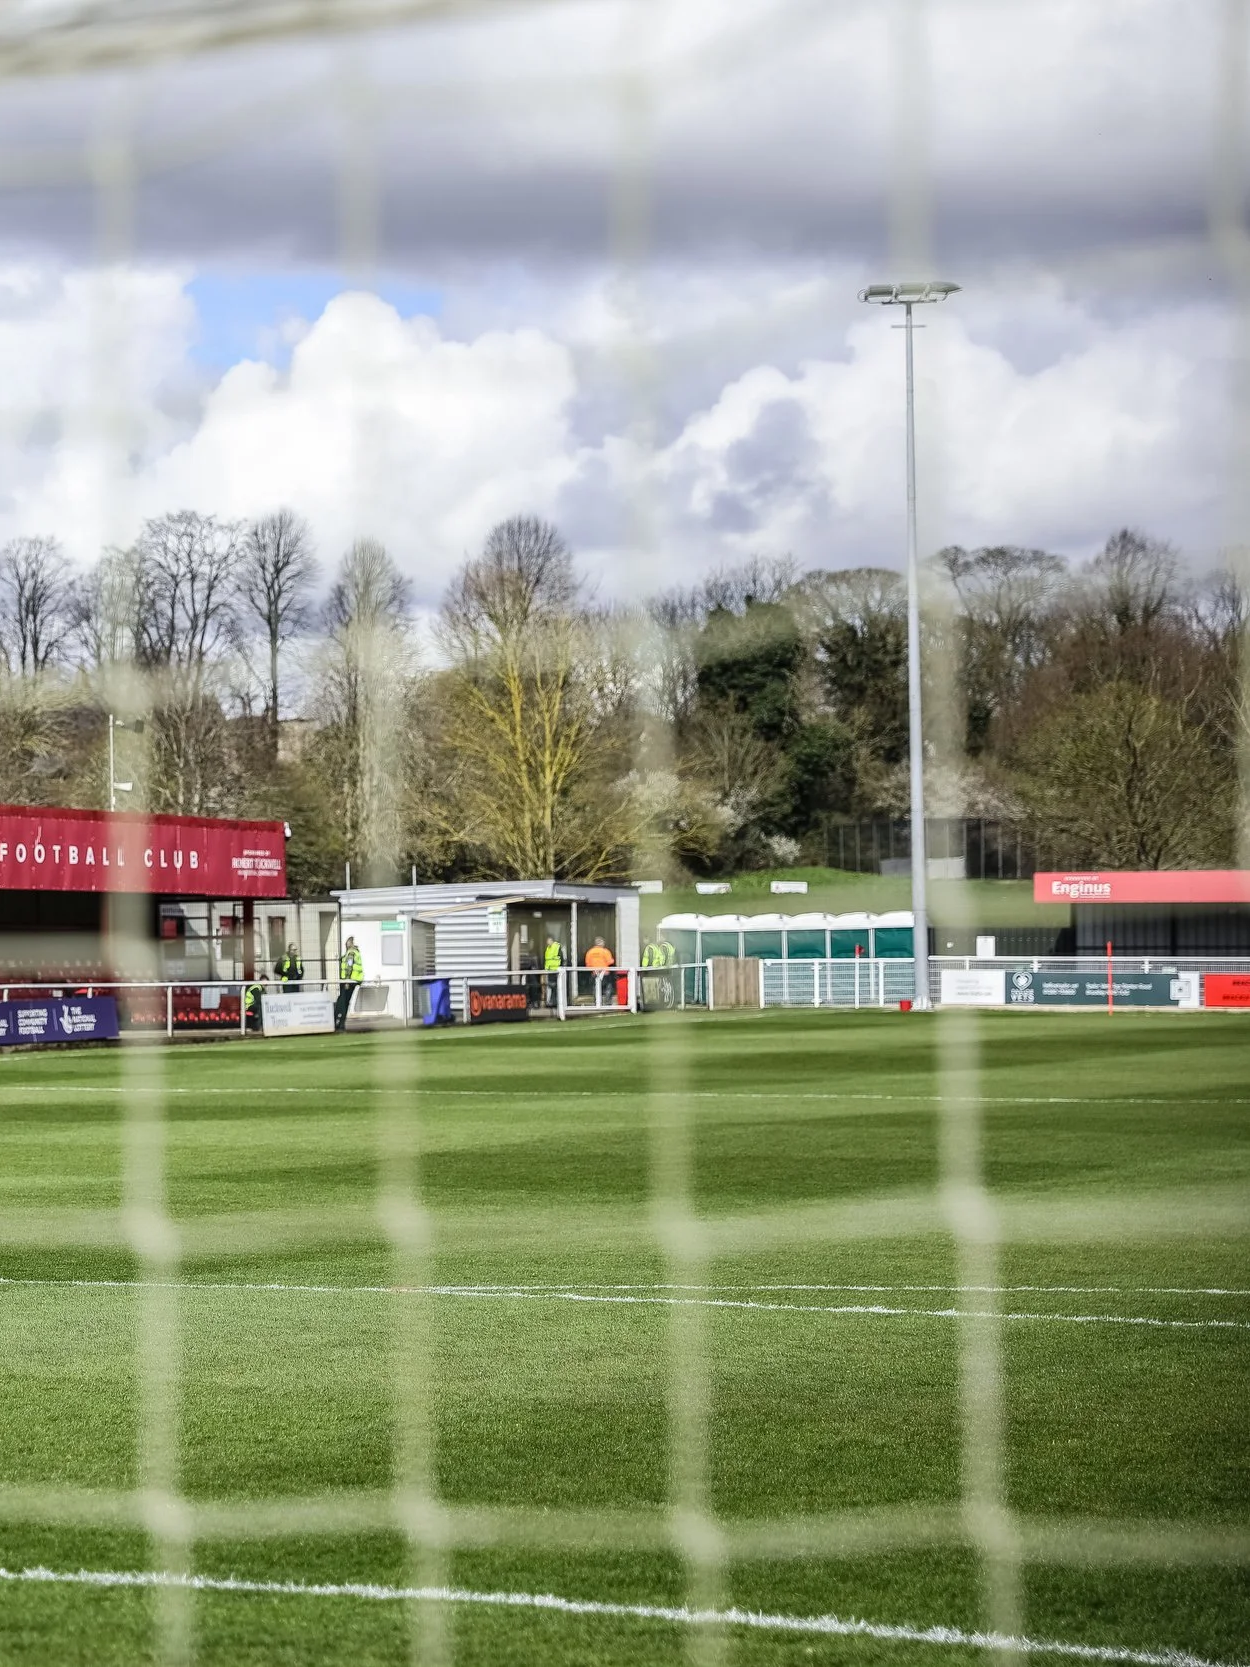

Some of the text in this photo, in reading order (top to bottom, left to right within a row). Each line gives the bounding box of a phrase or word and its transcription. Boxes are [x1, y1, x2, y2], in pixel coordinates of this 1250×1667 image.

[0, 841, 125, 867] FOOTBALL
[143, 848, 199, 869] CLUB
[1051, 880, 1111, 899] Enginus
[481, 993, 527, 1010] vanarama
